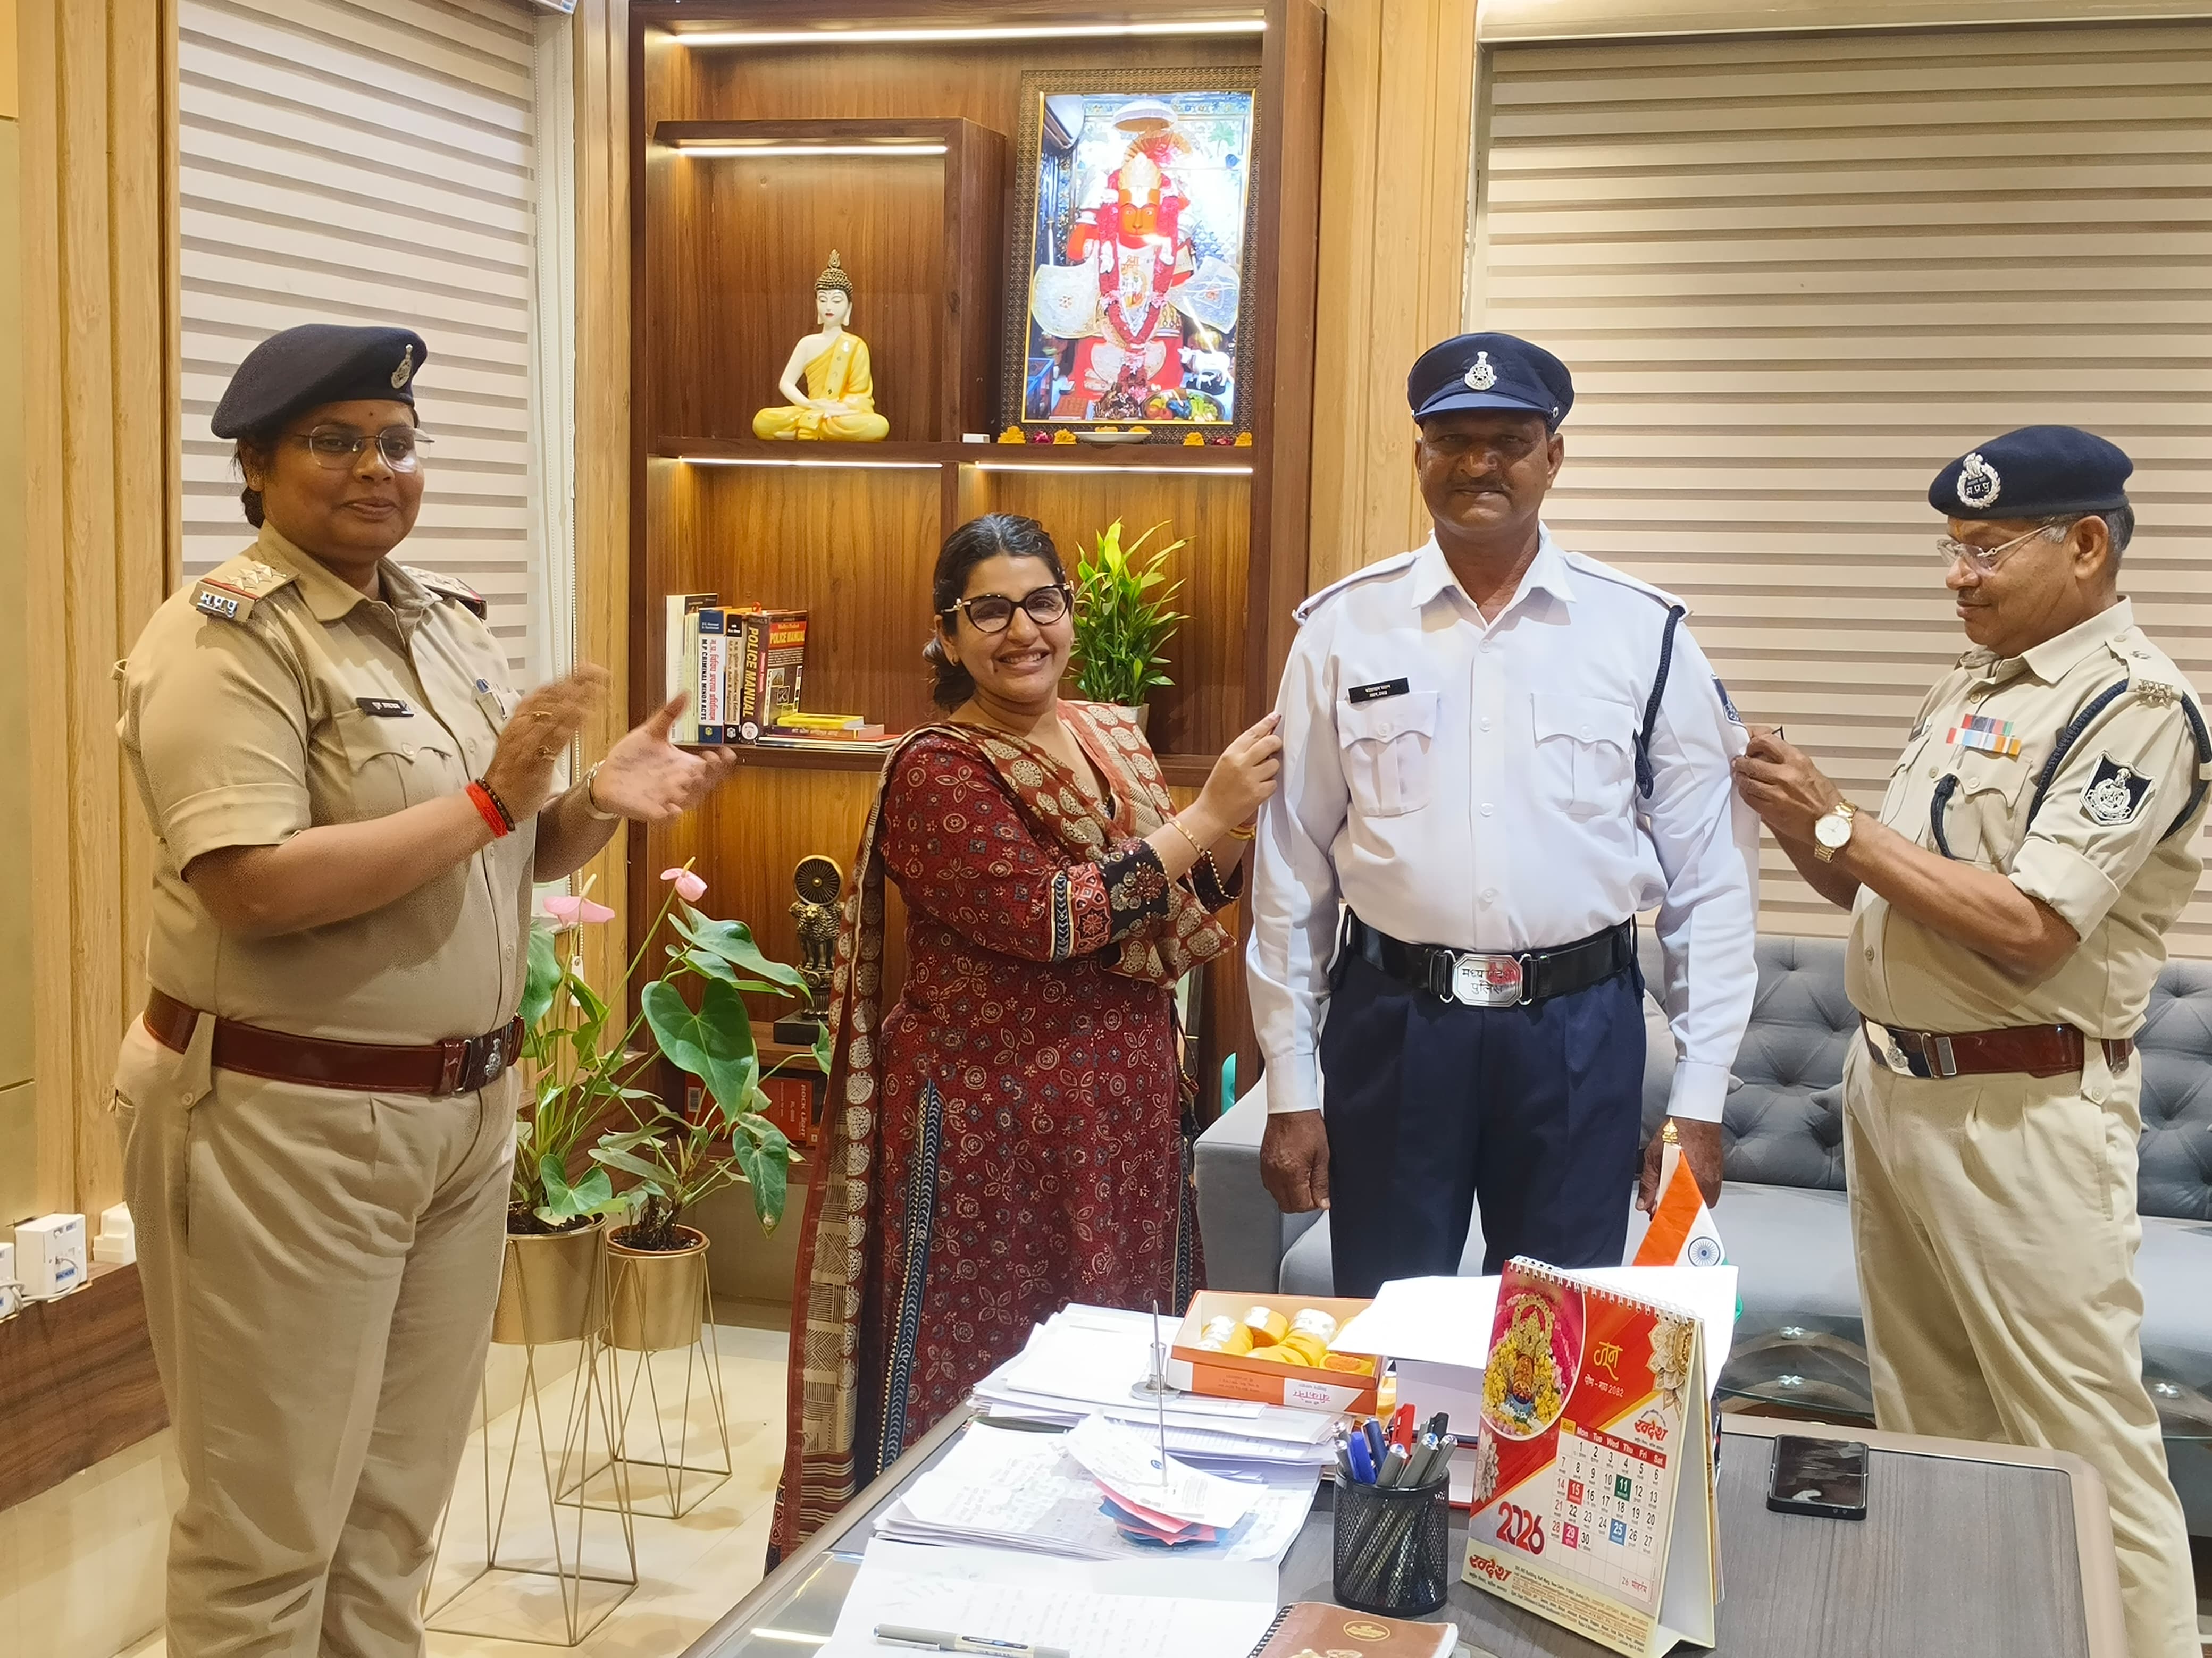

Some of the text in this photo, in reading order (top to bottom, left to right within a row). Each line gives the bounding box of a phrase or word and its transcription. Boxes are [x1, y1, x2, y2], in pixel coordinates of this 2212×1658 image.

[747, 627, 759, 669] POLICE
[770, 632, 786, 644] POLICE
[743, 670, 756, 717] MANUAL
[1593, 1341, 1623, 1381] जून
[1562, 1421, 1573, 1432] Sun
[1577, 1426, 1588, 1437] Mon
[1593, 1432, 1603, 1443] Tue
[1606, 1437, 1619, 1449] Wed
[1623, 1443, 1633, 1454] Thu
[1639, 1449, 1647, 1459] Fri
[1654, 1454, 1663, 1465] Sat
[1635, 1419, 1668, 1441] स्वदेश
[1562, 1456, 1658, 1503] 7 8 9 10 11 12 13
[1579, 1441, 1658, 1480] 1 2 3 4 5 6
[1557, 1477, 1655, 1525] 14 15 16 17 18 19 20
[1496, 1501, 1545, 1555] 2026
[1552, 1520, 1590, 1545] 28 29 30
[1555, 1499, 1653, 1547] 21 22 23 24 25 26 27
[1469, 1554, 1512, 1581] स्वदेश
[1622, 1576, 1629, 1586] 26
